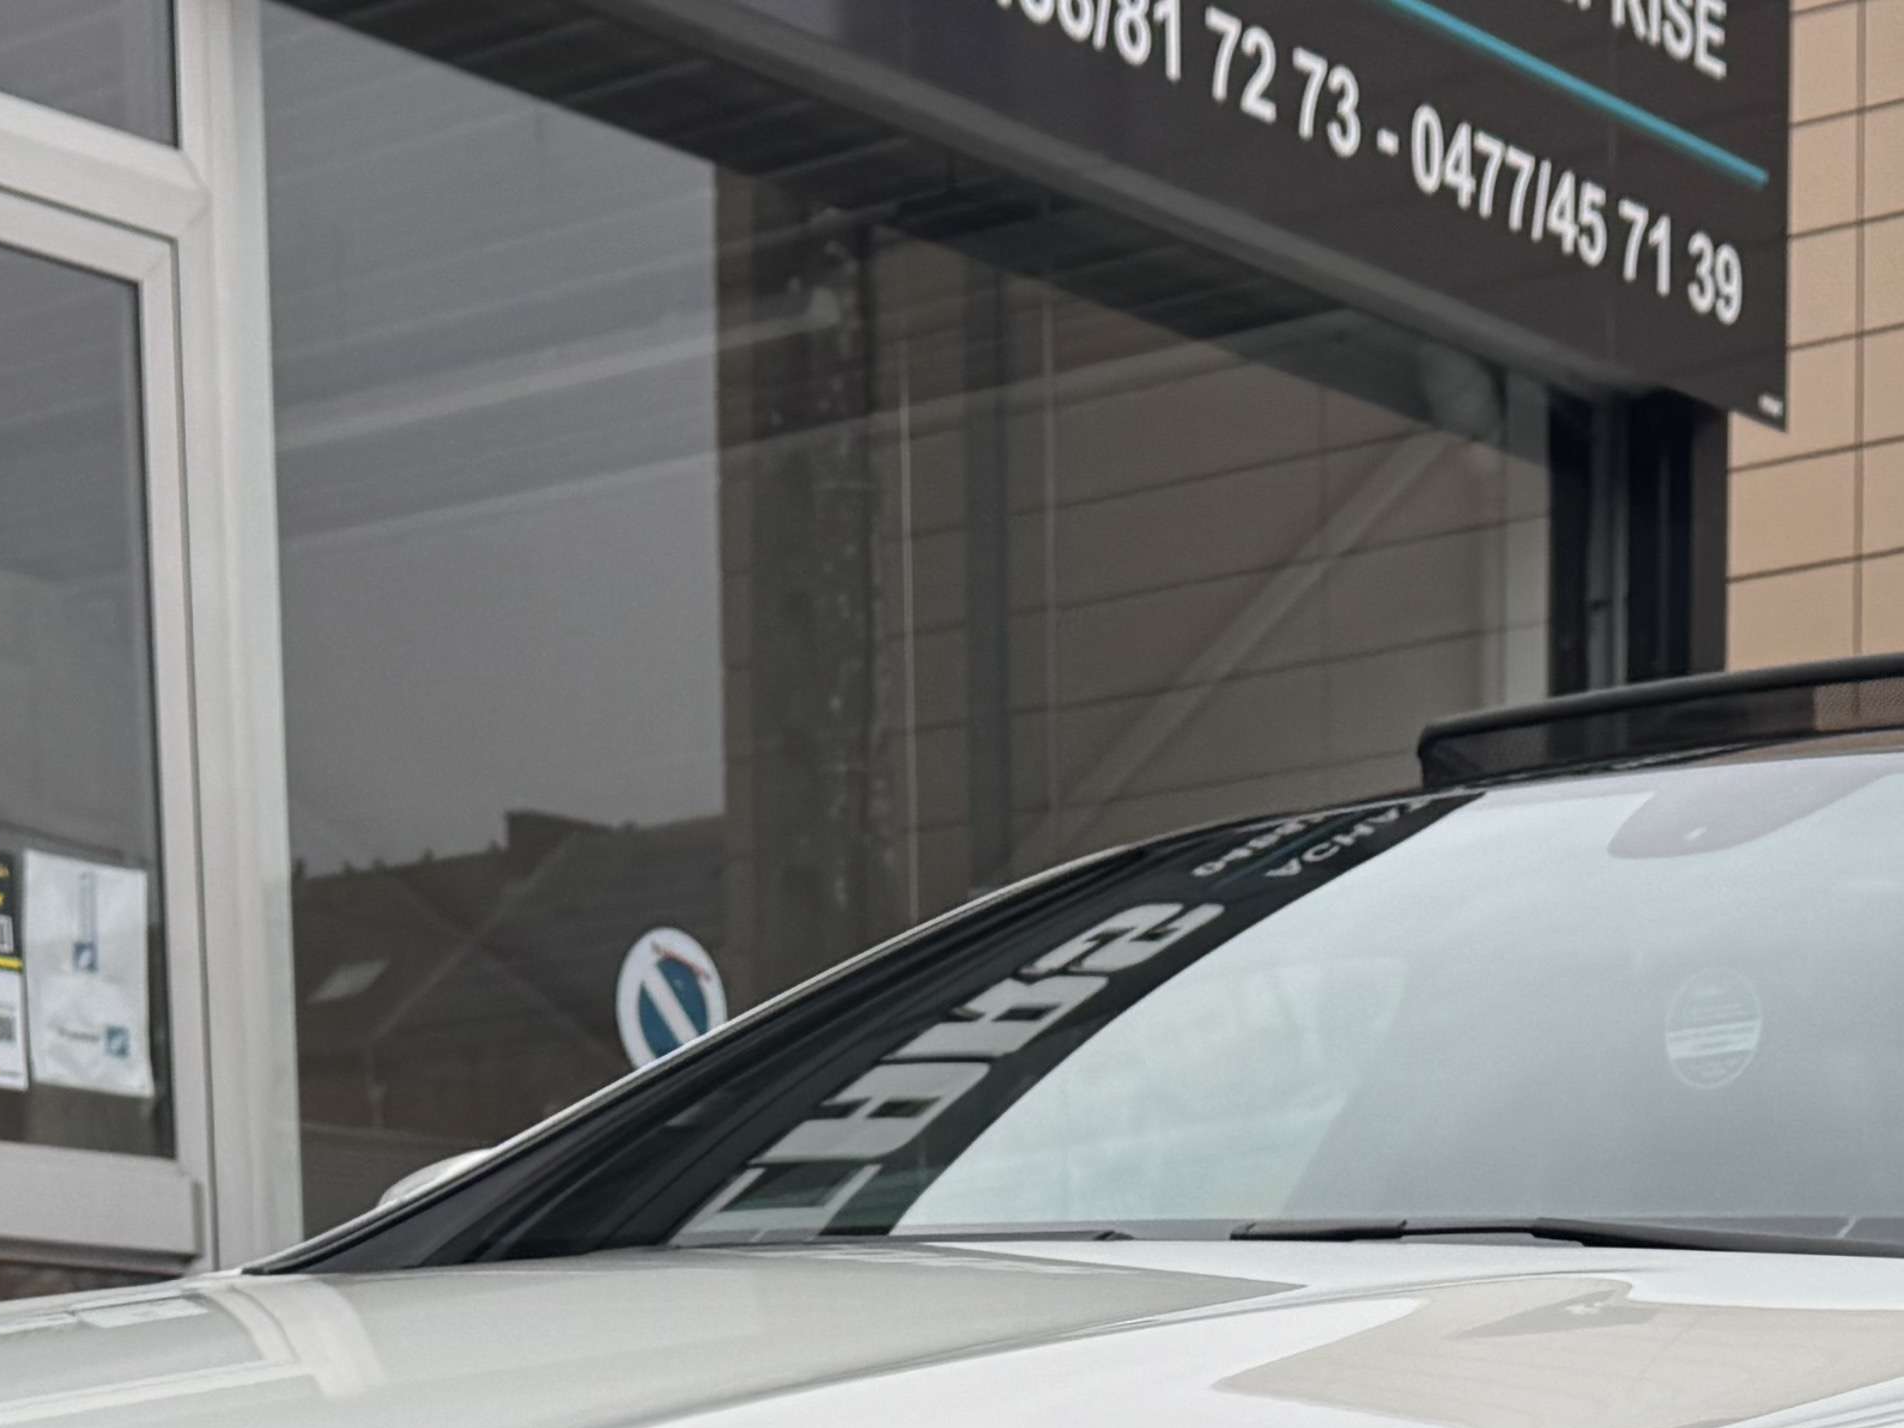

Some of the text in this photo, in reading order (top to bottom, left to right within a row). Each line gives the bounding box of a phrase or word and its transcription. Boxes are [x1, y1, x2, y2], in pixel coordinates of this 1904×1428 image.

[1204, 6, 1277, 124] 72
[1292, 46, 1361, 159] 73
[1410, 103, 1608, 267] 0477/45
[1618, 198, 1672, 297] 71
[1687, 231, 1744, 326] 39
